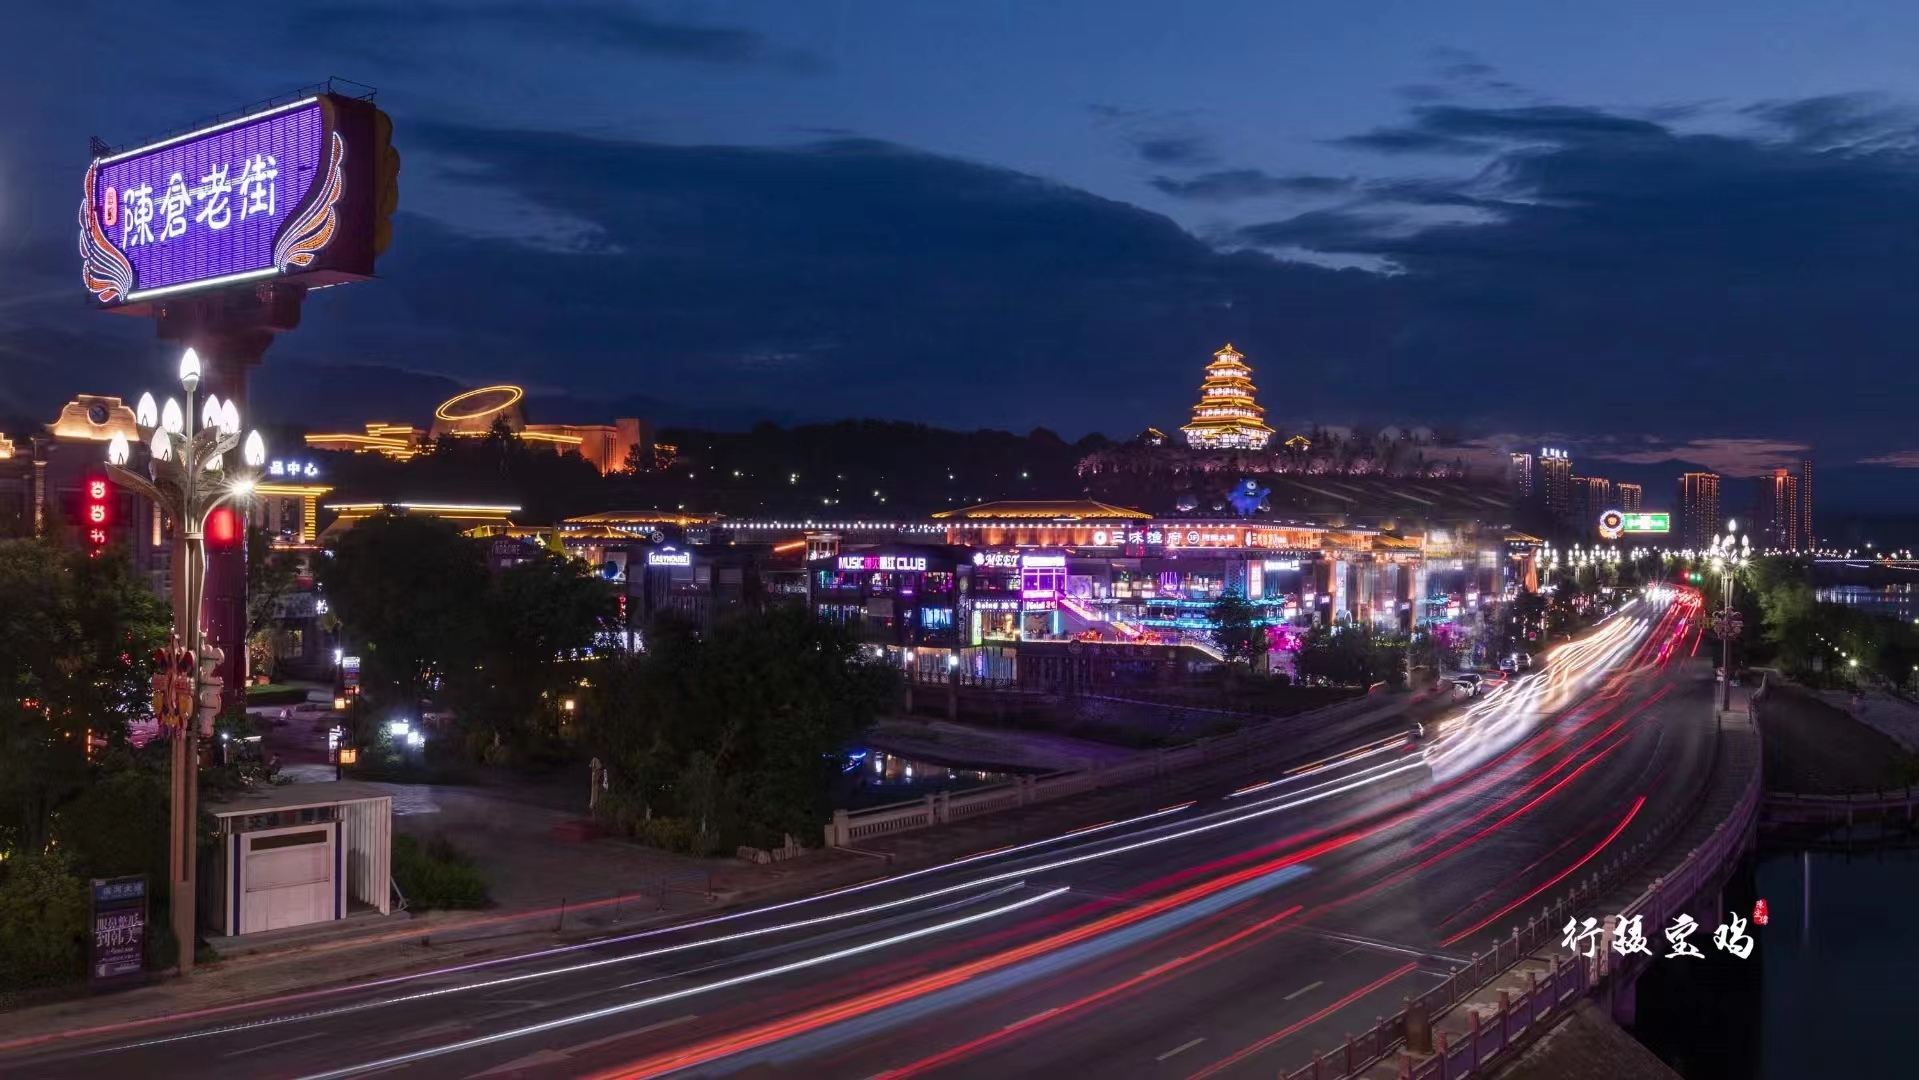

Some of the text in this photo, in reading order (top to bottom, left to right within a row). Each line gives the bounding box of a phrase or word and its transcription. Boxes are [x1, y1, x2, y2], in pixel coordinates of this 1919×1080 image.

[122, 153, 278, 249] 陳倉老街
[90, 481, 106, 558] 当当书
[838, 557, 865, 570] MUSIC
[896, 557, 926, 571] CLUB
